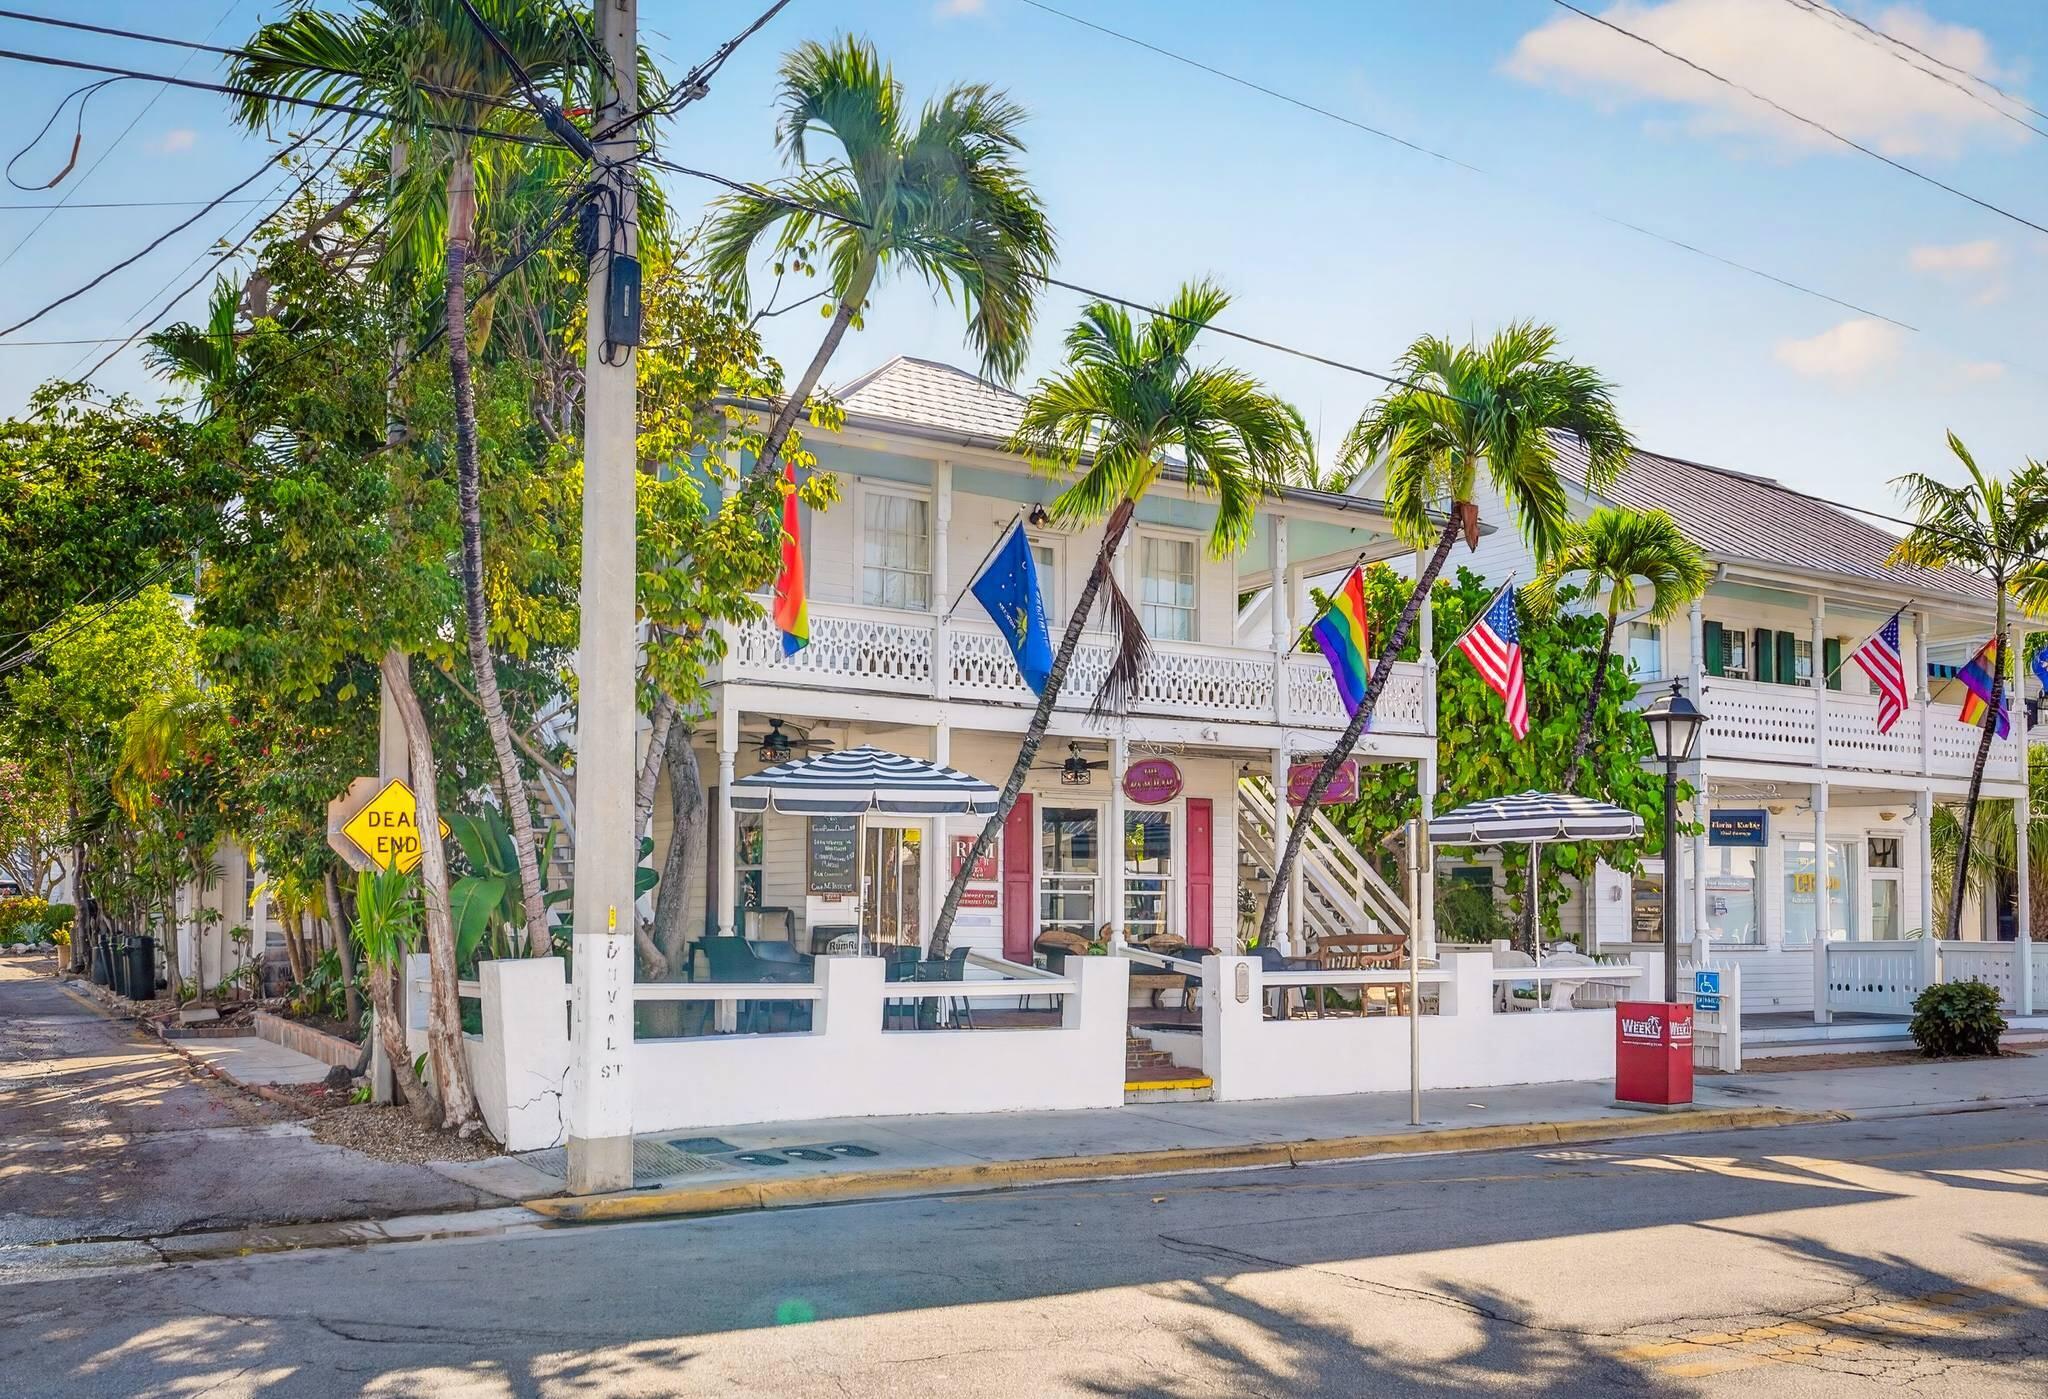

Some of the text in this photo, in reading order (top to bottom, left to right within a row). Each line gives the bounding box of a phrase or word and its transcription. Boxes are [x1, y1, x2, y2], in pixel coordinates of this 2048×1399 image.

[377, 836, 418, 853] END
[1621, 1018, 1662, 1039] WEEKLY
[601, 1064, 624, 1079] ST
